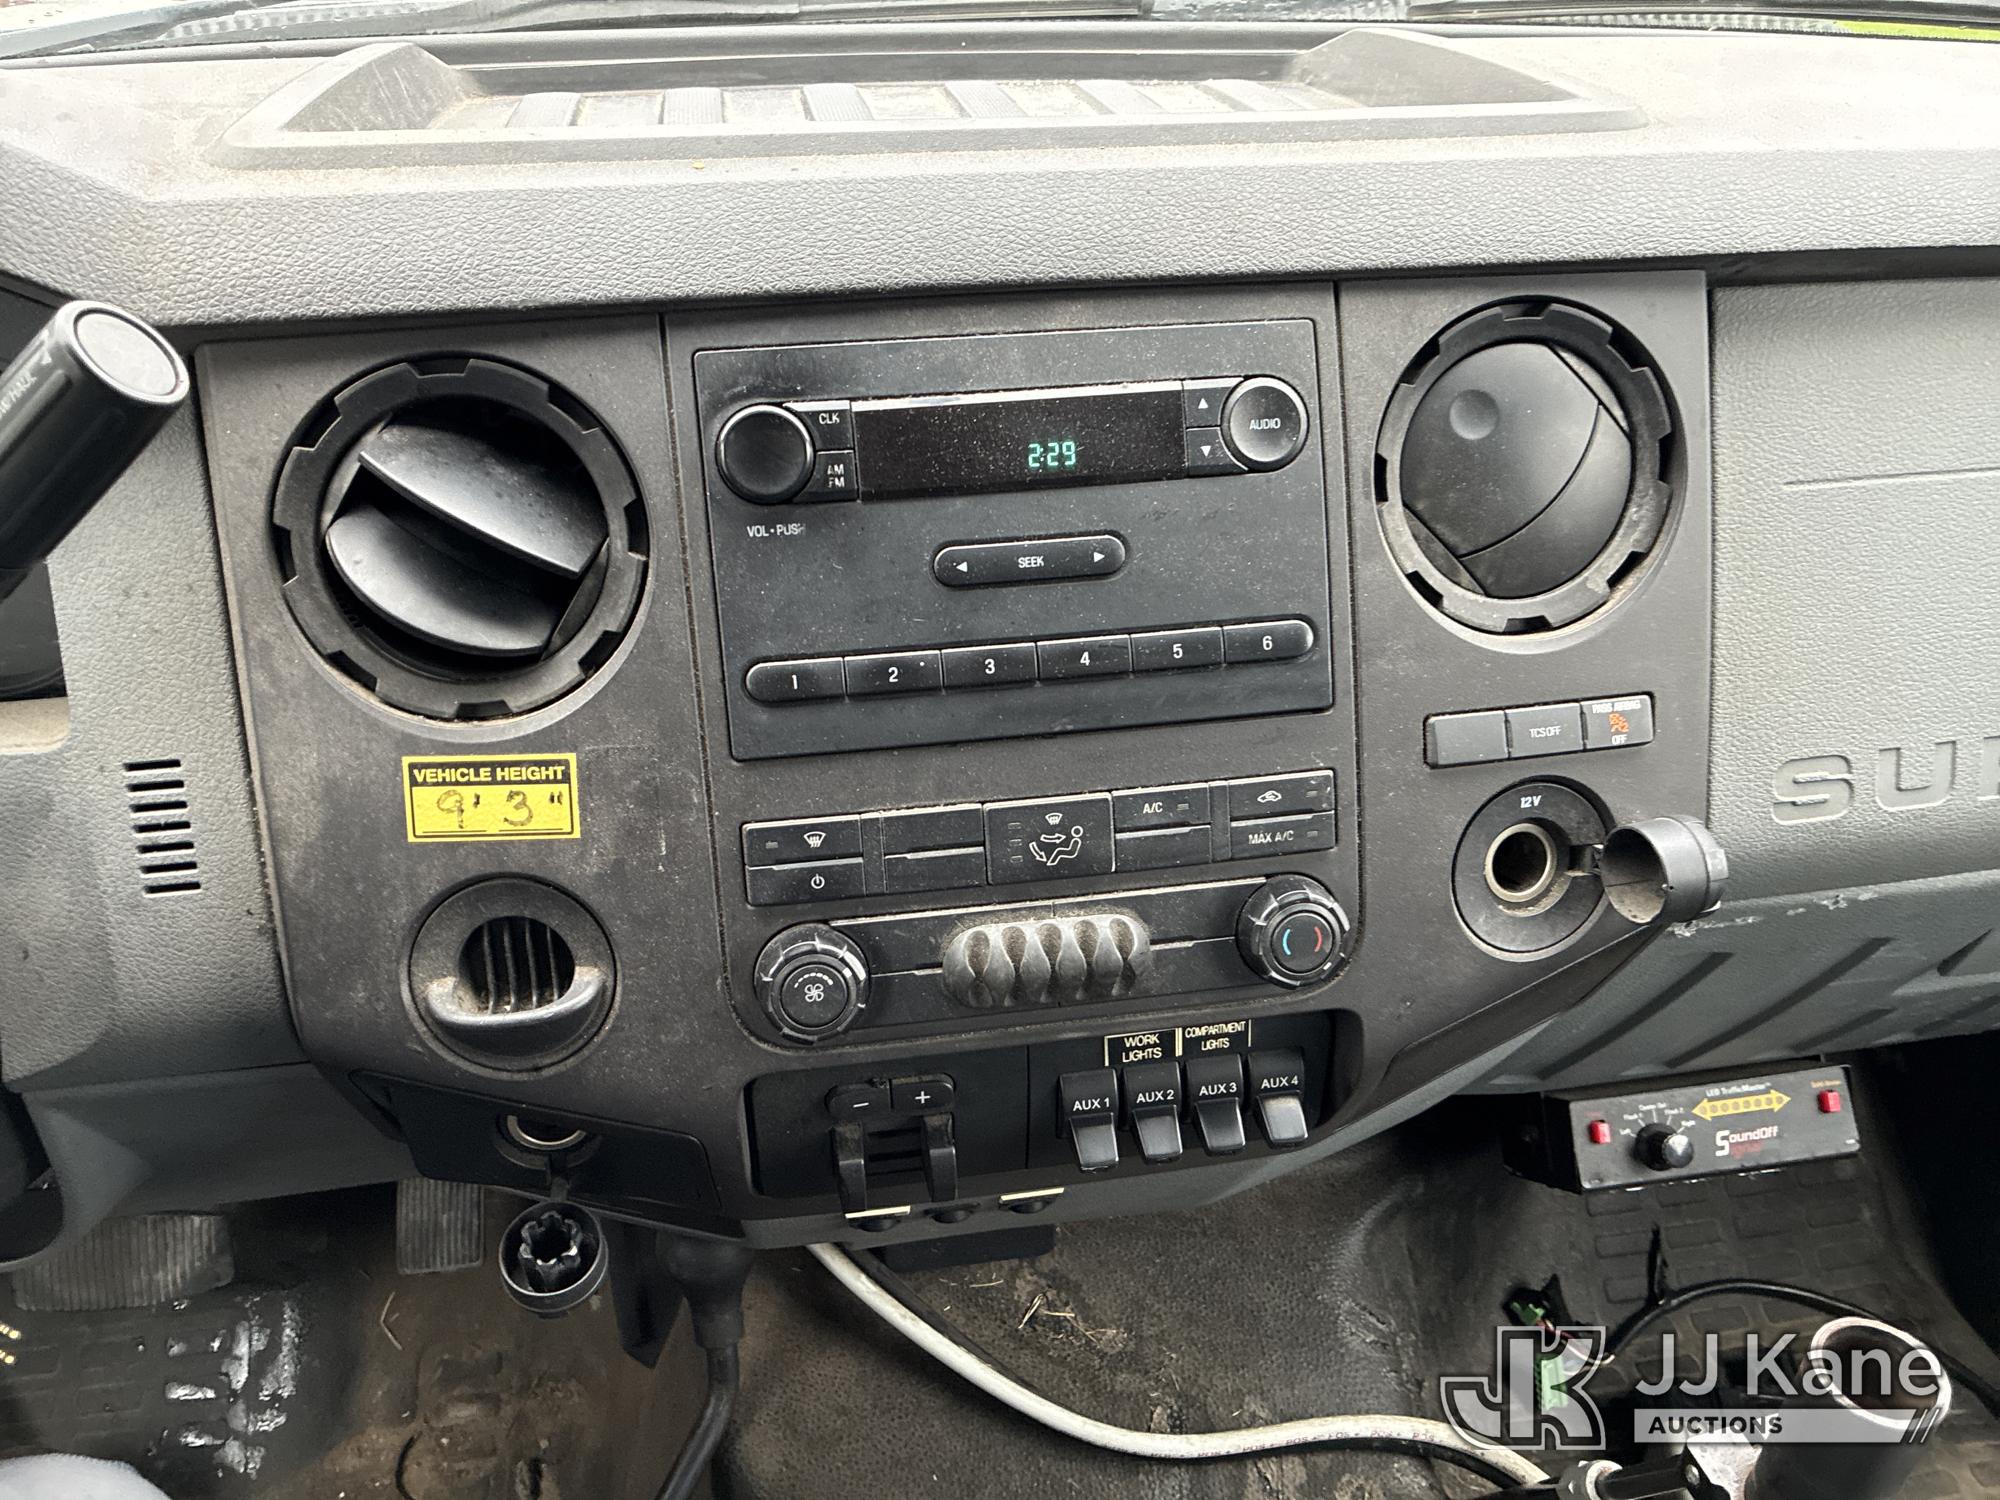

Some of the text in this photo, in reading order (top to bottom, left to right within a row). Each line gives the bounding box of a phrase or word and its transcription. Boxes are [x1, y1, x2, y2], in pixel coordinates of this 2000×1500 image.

[818, 412, 840, 425] CLK
[1249, 417, 1281, 430] AUDIO
[1028, 441, 1076, 468] 2:29
[827, 463, 845, 475] AM
[827, 476, 845, 488] FM
[746, 525, 769, 538] VOL
[1018, 555, 1045, 569] SEEK
[1262, 635, 1272, 651] 6
[1080, 651, 1090, 667] 4
[1173, 644, 1183, 659] 5
[984, 659, 995, 675] 3
[791, 674, 798, 689] 1
[888, 667, 899, 683] 2
[1529, 725, 1562, 738] TCS OFF
[1611, 734, 1628, 745] OFF
[413, 765, 566, 783] VEHICLE HEIGHT
[1772, 734, 2000, 824] SU
[1143, 802, 1163, 814] A/C
[1520, 796, 1541, 808] 12V
[1248, 830, 1294, 845] MAX A/C
[1185, 1021, 1246, 1038] COMPARTMENT
[1124, 1033, 1160, 1048] WORK
[1201, 1038, 1230, 1051] LIGHTS
[1122, 1047, 1162, 1063] LIGHTS
[1199, 1082, 1238, 1097] AUX 3
[1261, 1075, 1299, 1089] AUX 4
[1136, 1089, 1175, 1104] AUX 2
[1072, 1097, 1110, 1112] AUX 1
[1715, 1125, 1779, 1157] SoundOff
